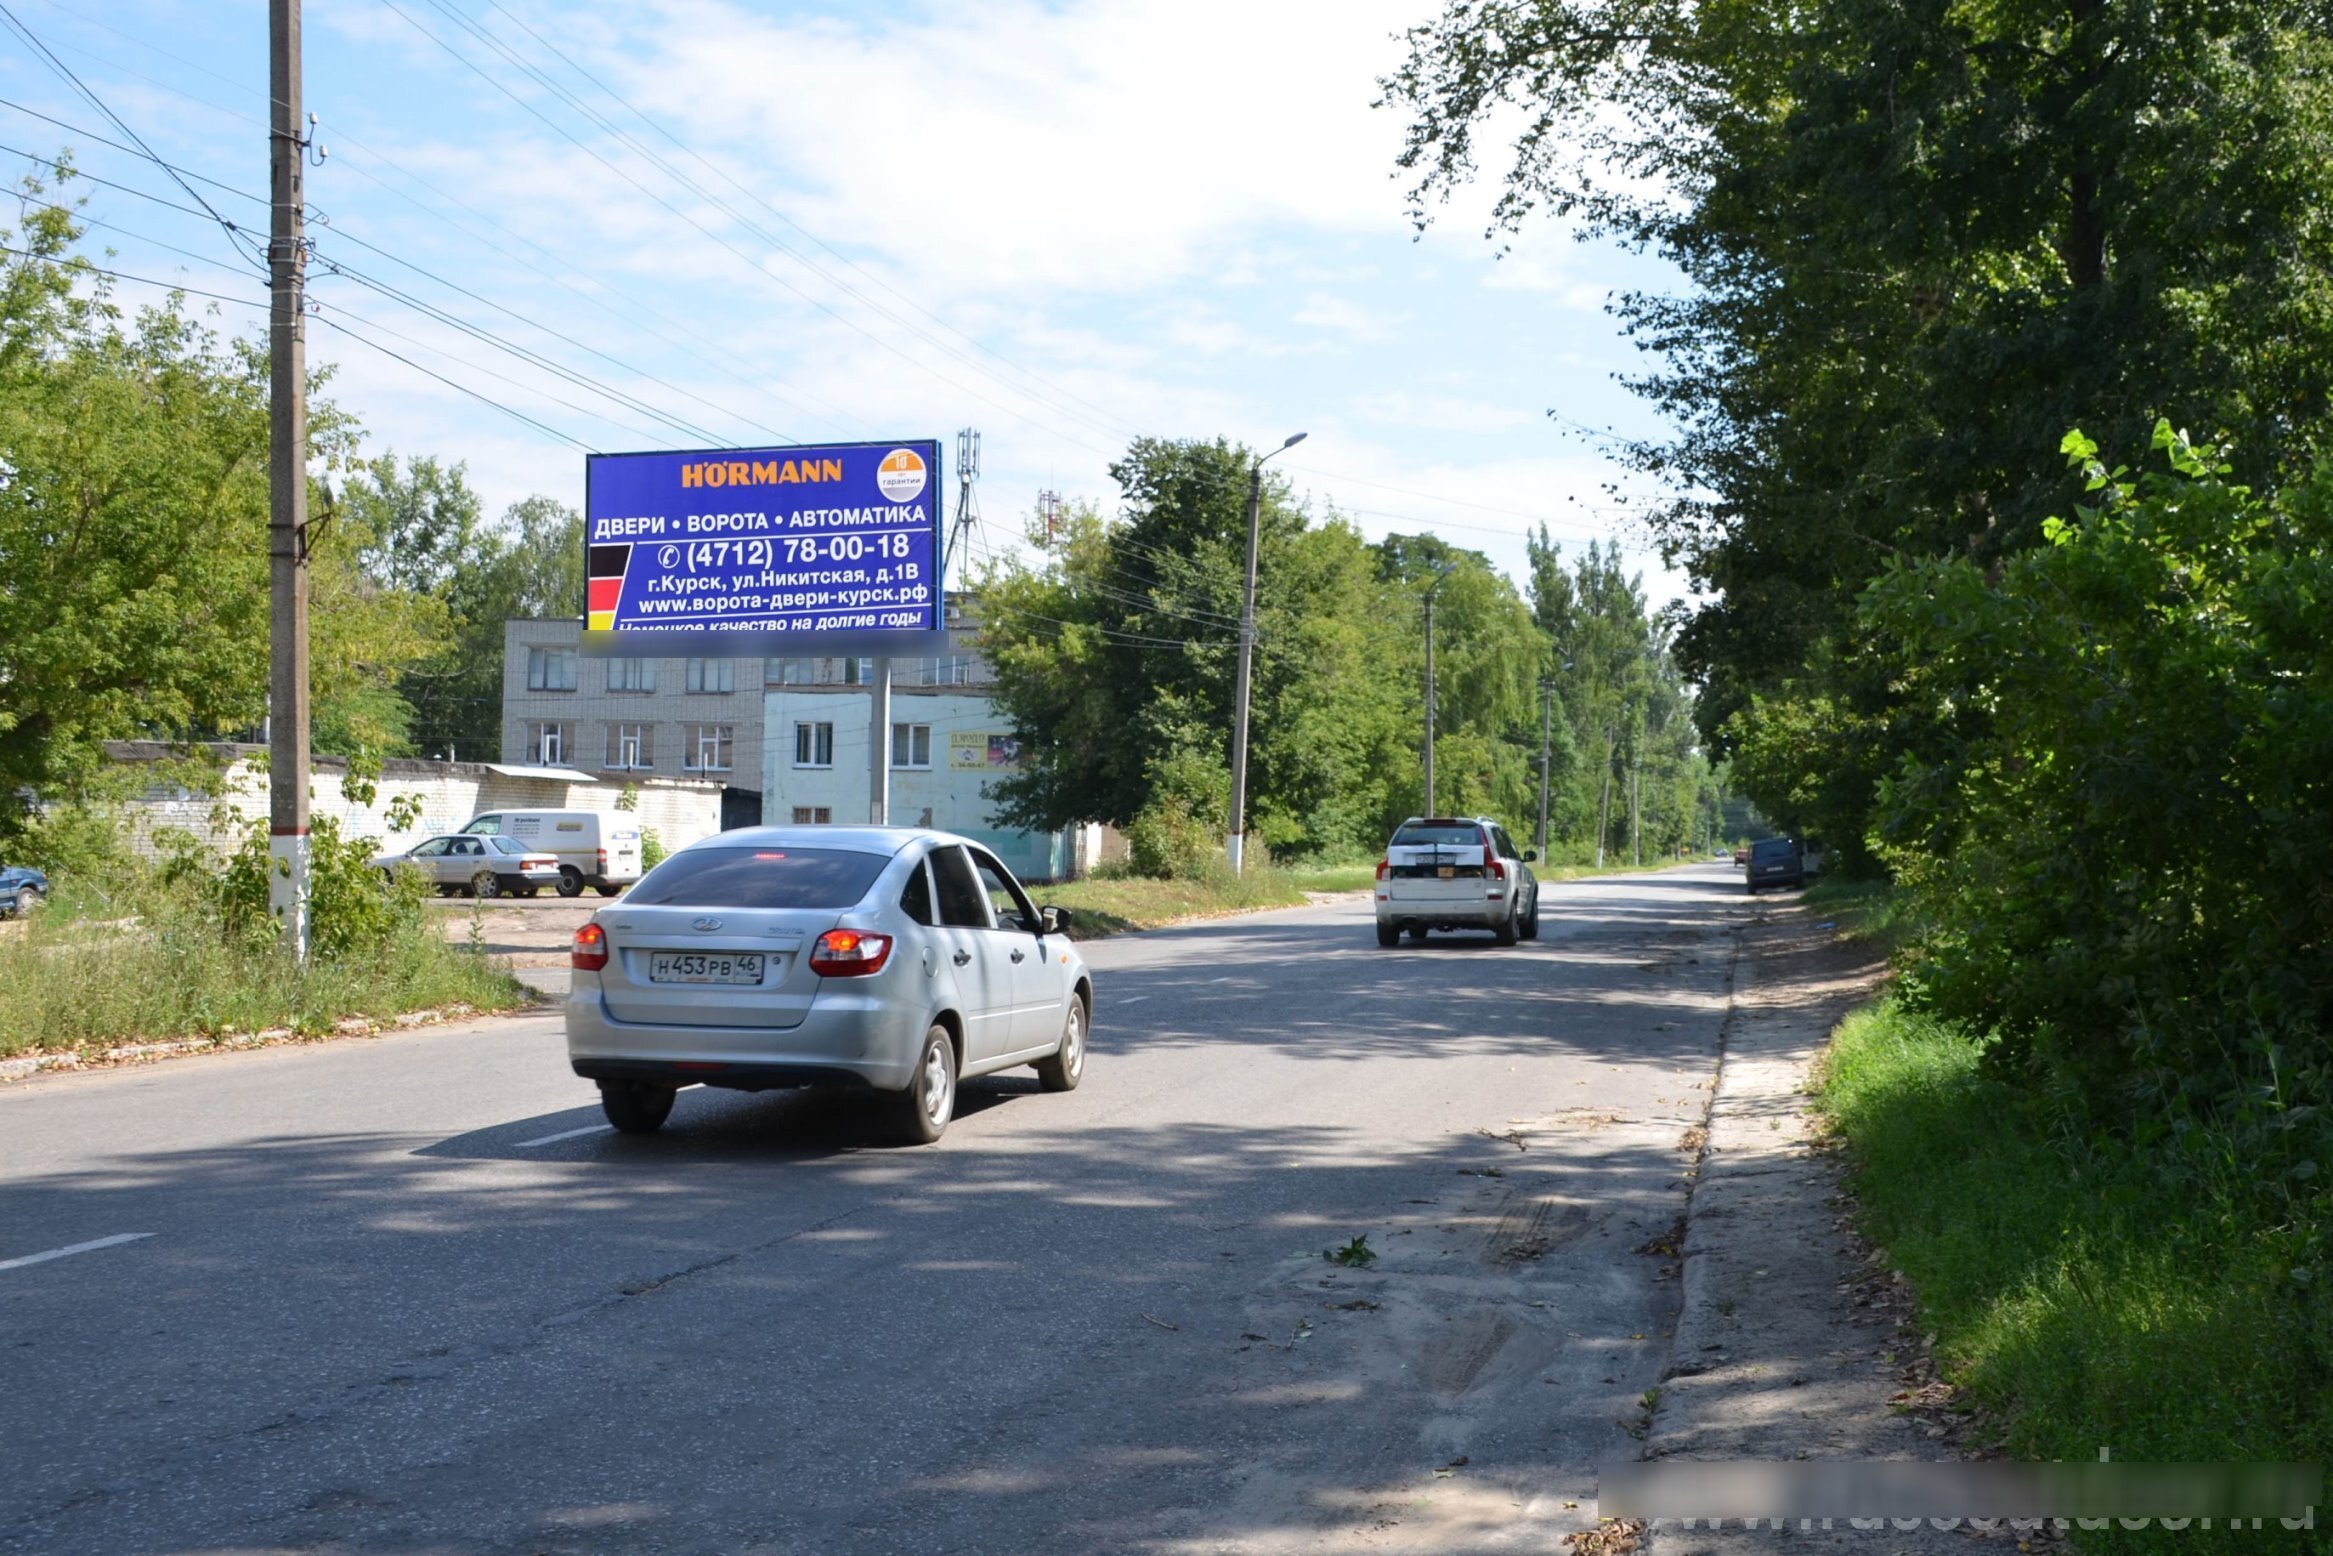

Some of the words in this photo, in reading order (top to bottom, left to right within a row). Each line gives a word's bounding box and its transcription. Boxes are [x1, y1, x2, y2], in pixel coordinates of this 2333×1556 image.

[682, 458, 842, 488] HÖRMANN
[882, 478, 921, 486] гарантии
[594, 516, 665, 540] ДВЕРИ
[687, 512, 769, 533] ВОРОТА
[789, 505, 926, 528] АВТОМАТИКА
[687, 539, 773, 573] (4712)
[783, 533, 910, 564] 78-00-18
[648, 575, 727, 595] г.Курск,
[732, 569, 871, 592] ул.Никитская,
[876, 563, 919, 583] д.1В
[639, 583, 928, 613] www.ворота-двери-курск.рф
[791, 618, 812, 630] на
[816, 614, 876, 630] долгие
[880, 612, 922, 627] годы
[737, 956, 756, 972] 46
